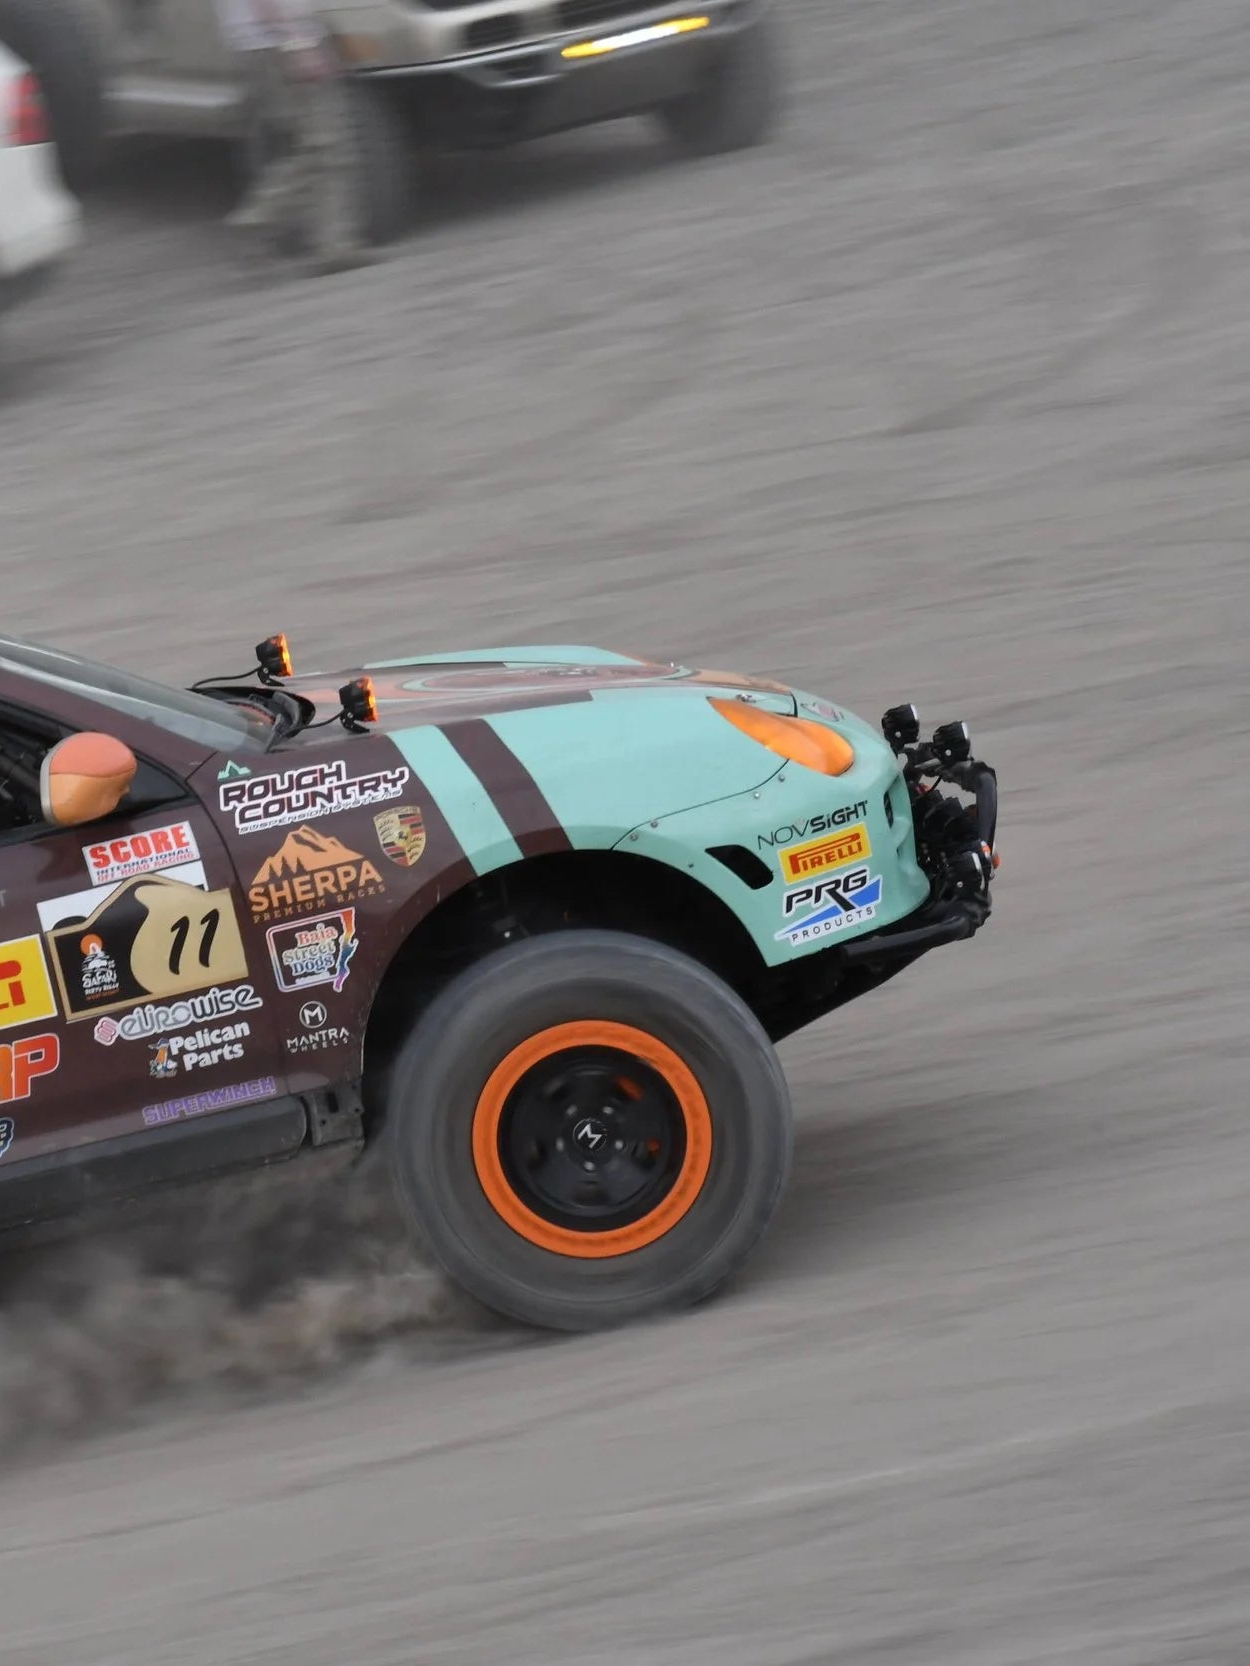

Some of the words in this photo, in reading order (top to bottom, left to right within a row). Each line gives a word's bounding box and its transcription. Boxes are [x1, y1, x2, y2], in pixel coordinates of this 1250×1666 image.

[221, 762, 345, 810] ROUGH
[237, 769, 407, 826] COUNTRY
[89, 825, 190, 868] SCORE
[97, 848, 190, 876] INTERNATIONAL
[121, 864, 150, 876] ROAD
[154, 853, 194, 867] RACING
[789, 832, 863, 875] PIRELLI
[249, 861, 383, 912] SHERPA
[254, 899, 326, 924] PREMIUM
[338, 884, 386, 904] RACKS
[785, 868, 868, 914] PRG
[168, 908, 220, 975] 11
[791, 906, 873, 942] PRODUCTS
[292, 954, 335, 977] Dogs
[169, 1022, 250, 1055] Pelican
[183, 1043, 244, 1071] Parts
[287, 1027, 350, 1049] MANTRA
[142, 1076, 277, 1126] SUPERWINCH
